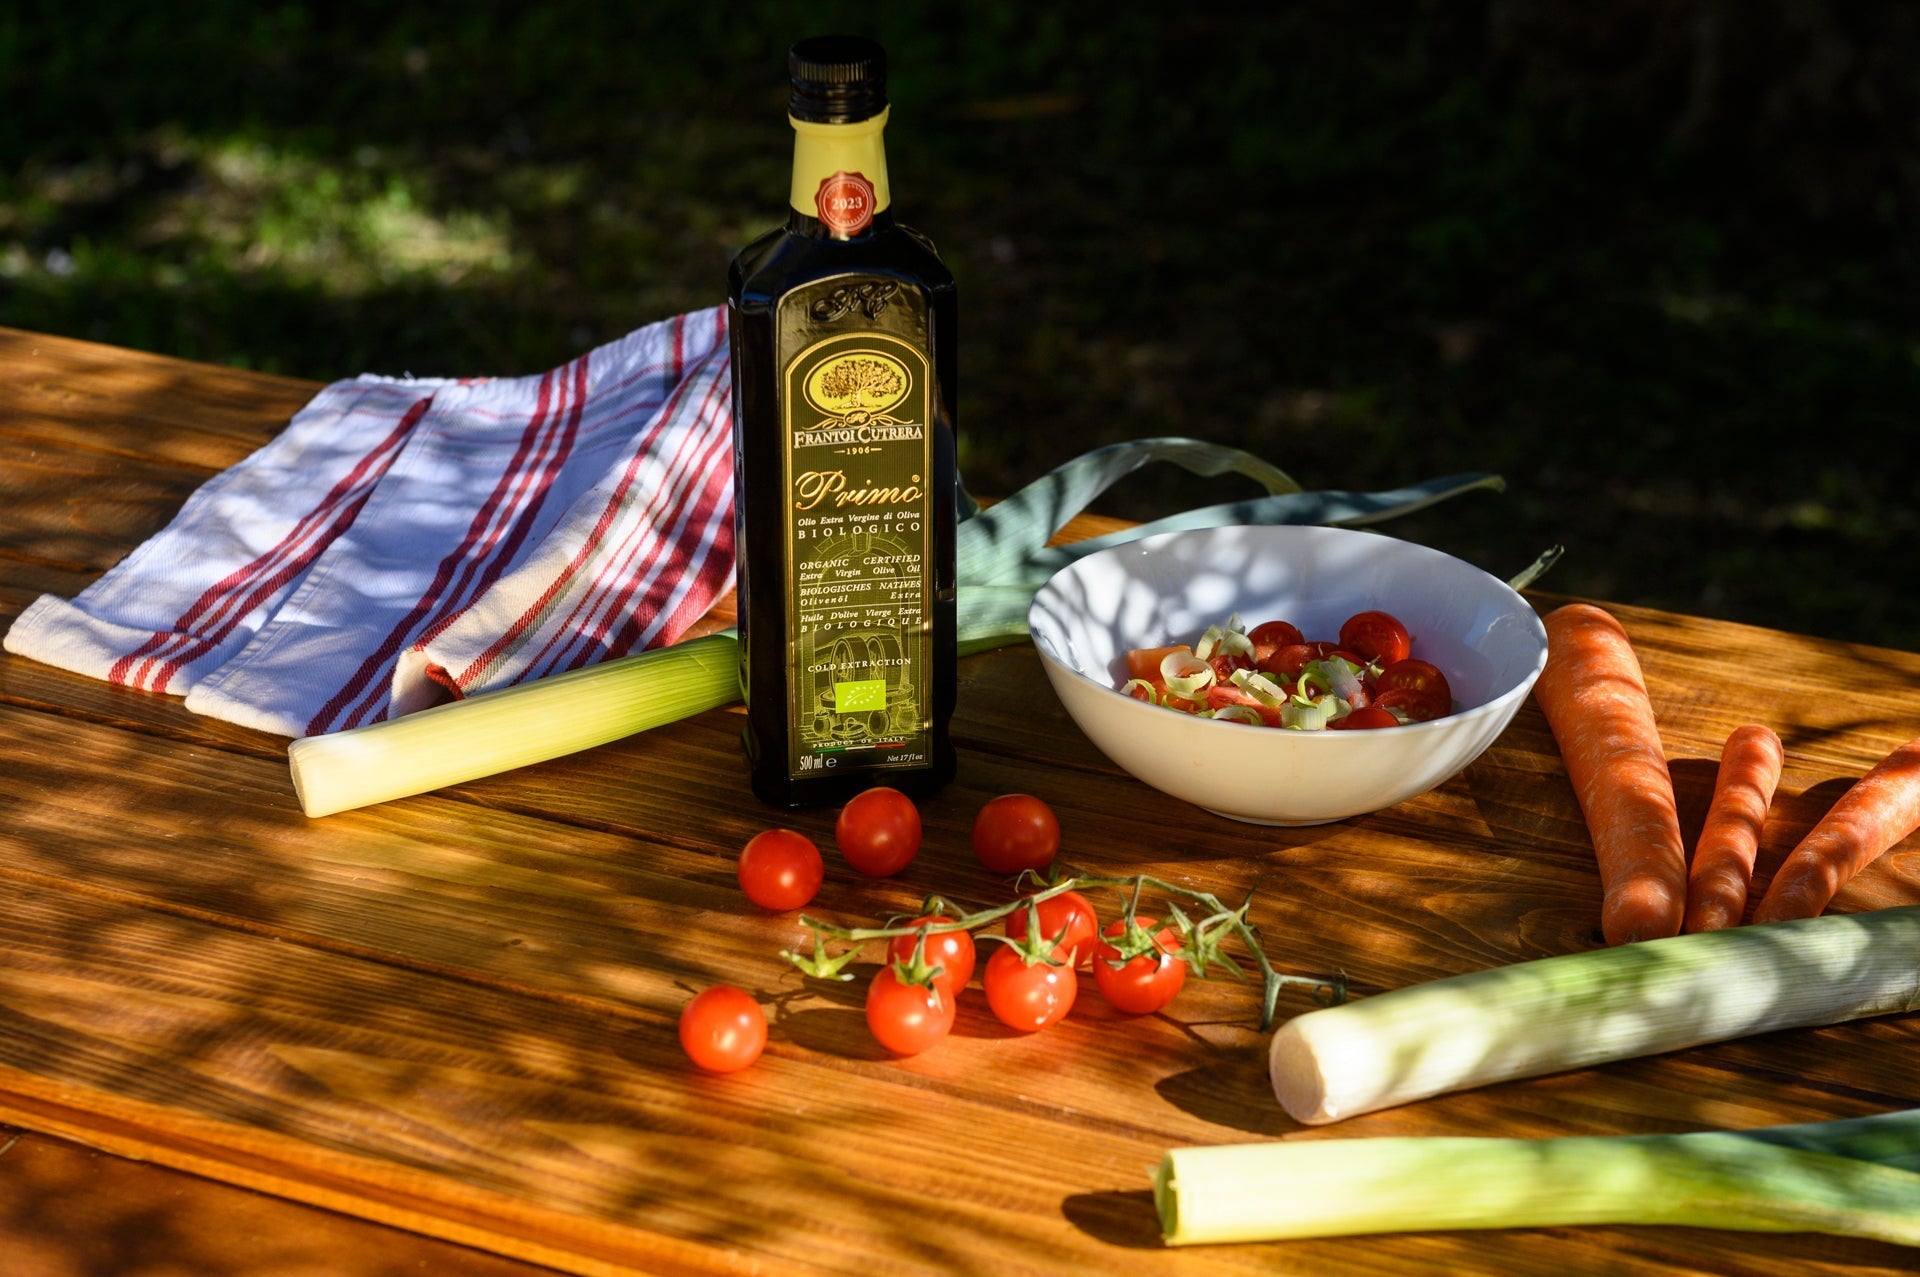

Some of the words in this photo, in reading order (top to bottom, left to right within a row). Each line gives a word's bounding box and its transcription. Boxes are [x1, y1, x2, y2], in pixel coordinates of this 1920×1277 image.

[831, 197, 863, 210] 2023
[846, 446, 870, 455] 1906
[798, 518, 817, 527] Olio
[820, 516, 843, 525] Extra
[848, 513, 880, 523] Vergine
[883, 512, 893, 520] di
[897, 511, 920, 519] Oliva
[800, 559, 850, 570] ORGANIC
[863, 554, 921, 565] CERTIFIED
[800, 572, 823, 581] Extra
[835, 569, 861, 578] Virgin
[873, 567, 895, 575] Olive
[907, 564, 920, 573] Oil
[800, 583, 872, 596] BIOLOGISCHES
[879, 580, 922, 590] NATIVES
[800, 595, 849, 606] Olivenöl
[890, 591, 922, 600] Extra
[801, 614, 824, 622] Huile
[830, 611, 859, 620] D'olive
[866, 609, 891, 618] Vierge
[898, 607, 922, 615] Extra
[807, 664, 837, 673] COLD
[841, 657, 912, 669] EXTRACTION
[813, 740, 854, 748] PRODUCT
[800, 755, 812, 770] 500
[813, 753, 823, 769] ml
